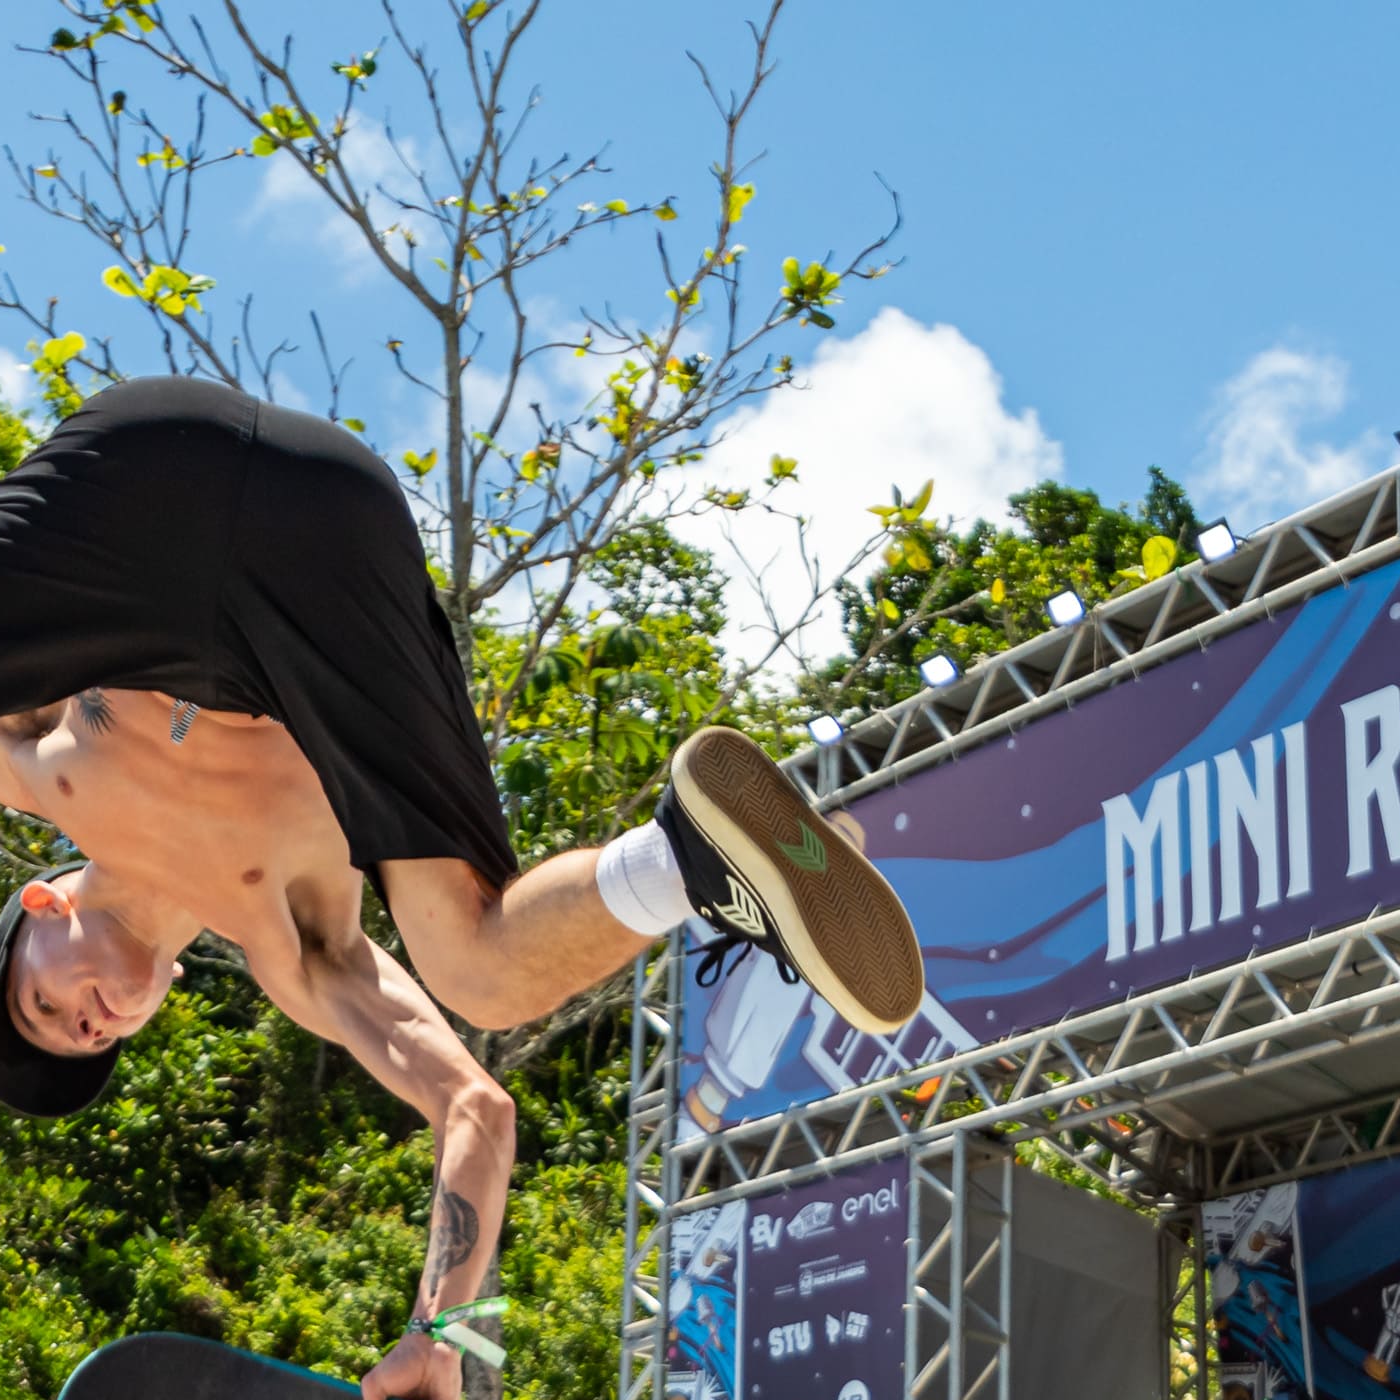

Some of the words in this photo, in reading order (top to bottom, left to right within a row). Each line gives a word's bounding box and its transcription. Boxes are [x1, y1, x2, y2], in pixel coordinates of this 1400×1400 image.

[1102, 720, 1312, 962] MINI
[841, 1178, 899, 1222] enel
[768, 1320, 813, 1357] STU
